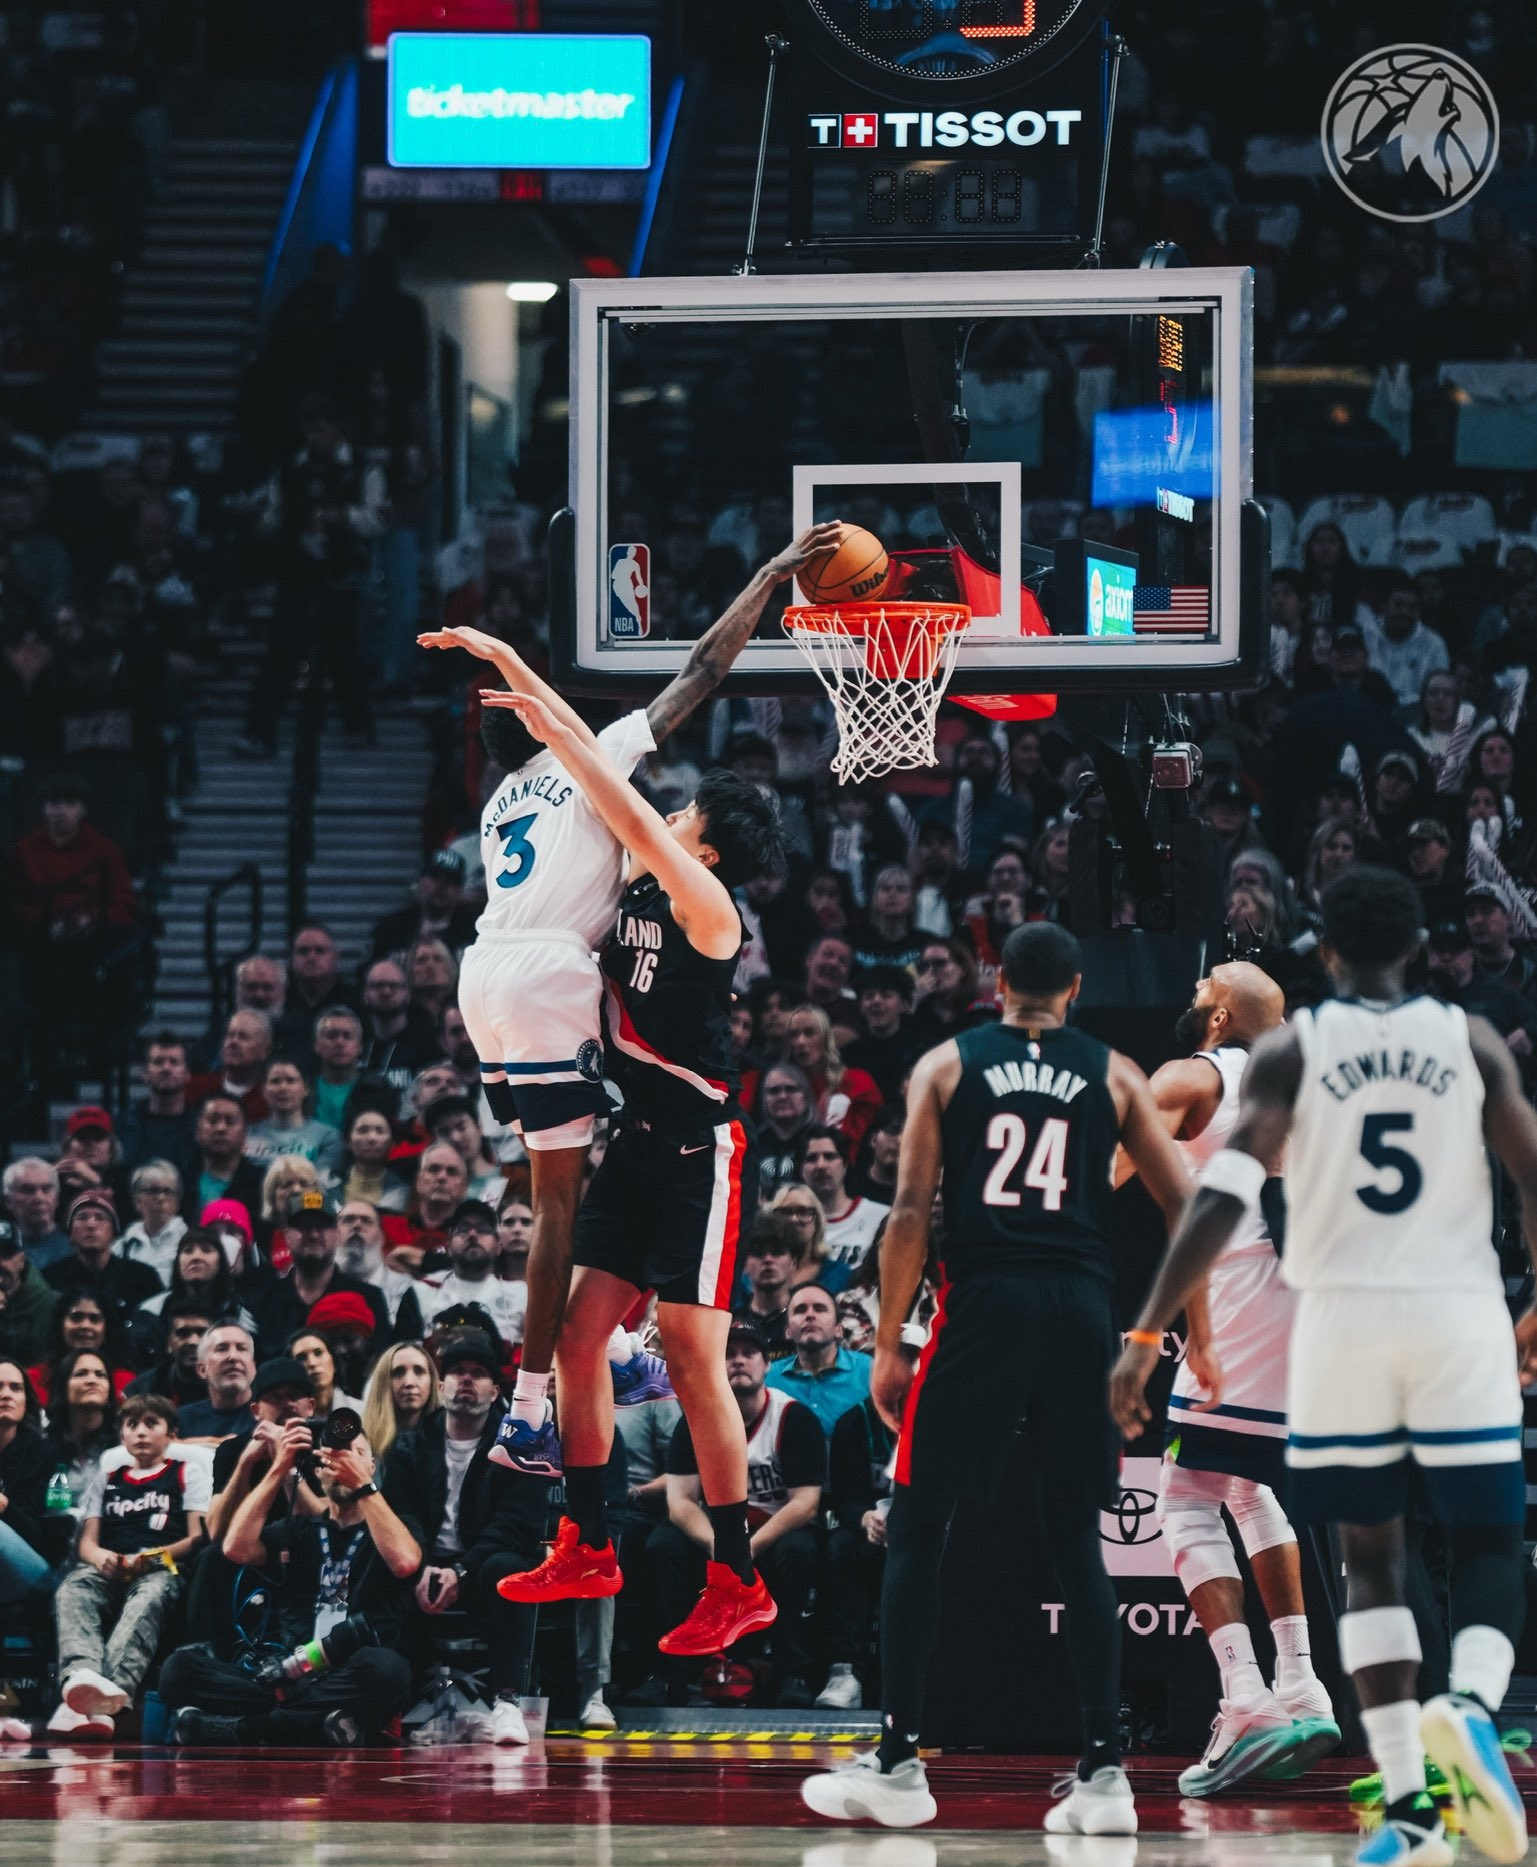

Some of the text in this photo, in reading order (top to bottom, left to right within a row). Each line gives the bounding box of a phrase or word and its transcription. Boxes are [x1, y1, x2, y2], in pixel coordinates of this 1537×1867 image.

[407, 84, 635, 120] ticketmaster
[884, 110, 1082, 148] TISSOT
[614, 617, 634, 632] NBA
[496, 812, 539, 889] 3
[617, 911, 663, 950] AND
[629, 948, 659, 993] 16
[983, 1061, 1088, 1104] MURRAY
[1321, 1050, 1457, 1101] EDWARDS
[983, 1113, 1069, 1211] 24
[1356, 1112, 1423, 1216] 5
[502, 1423, 518, 1438] W
[747, 1454, 783, 1493] ERS
[106, 1490, 169, 1517] ripcity
